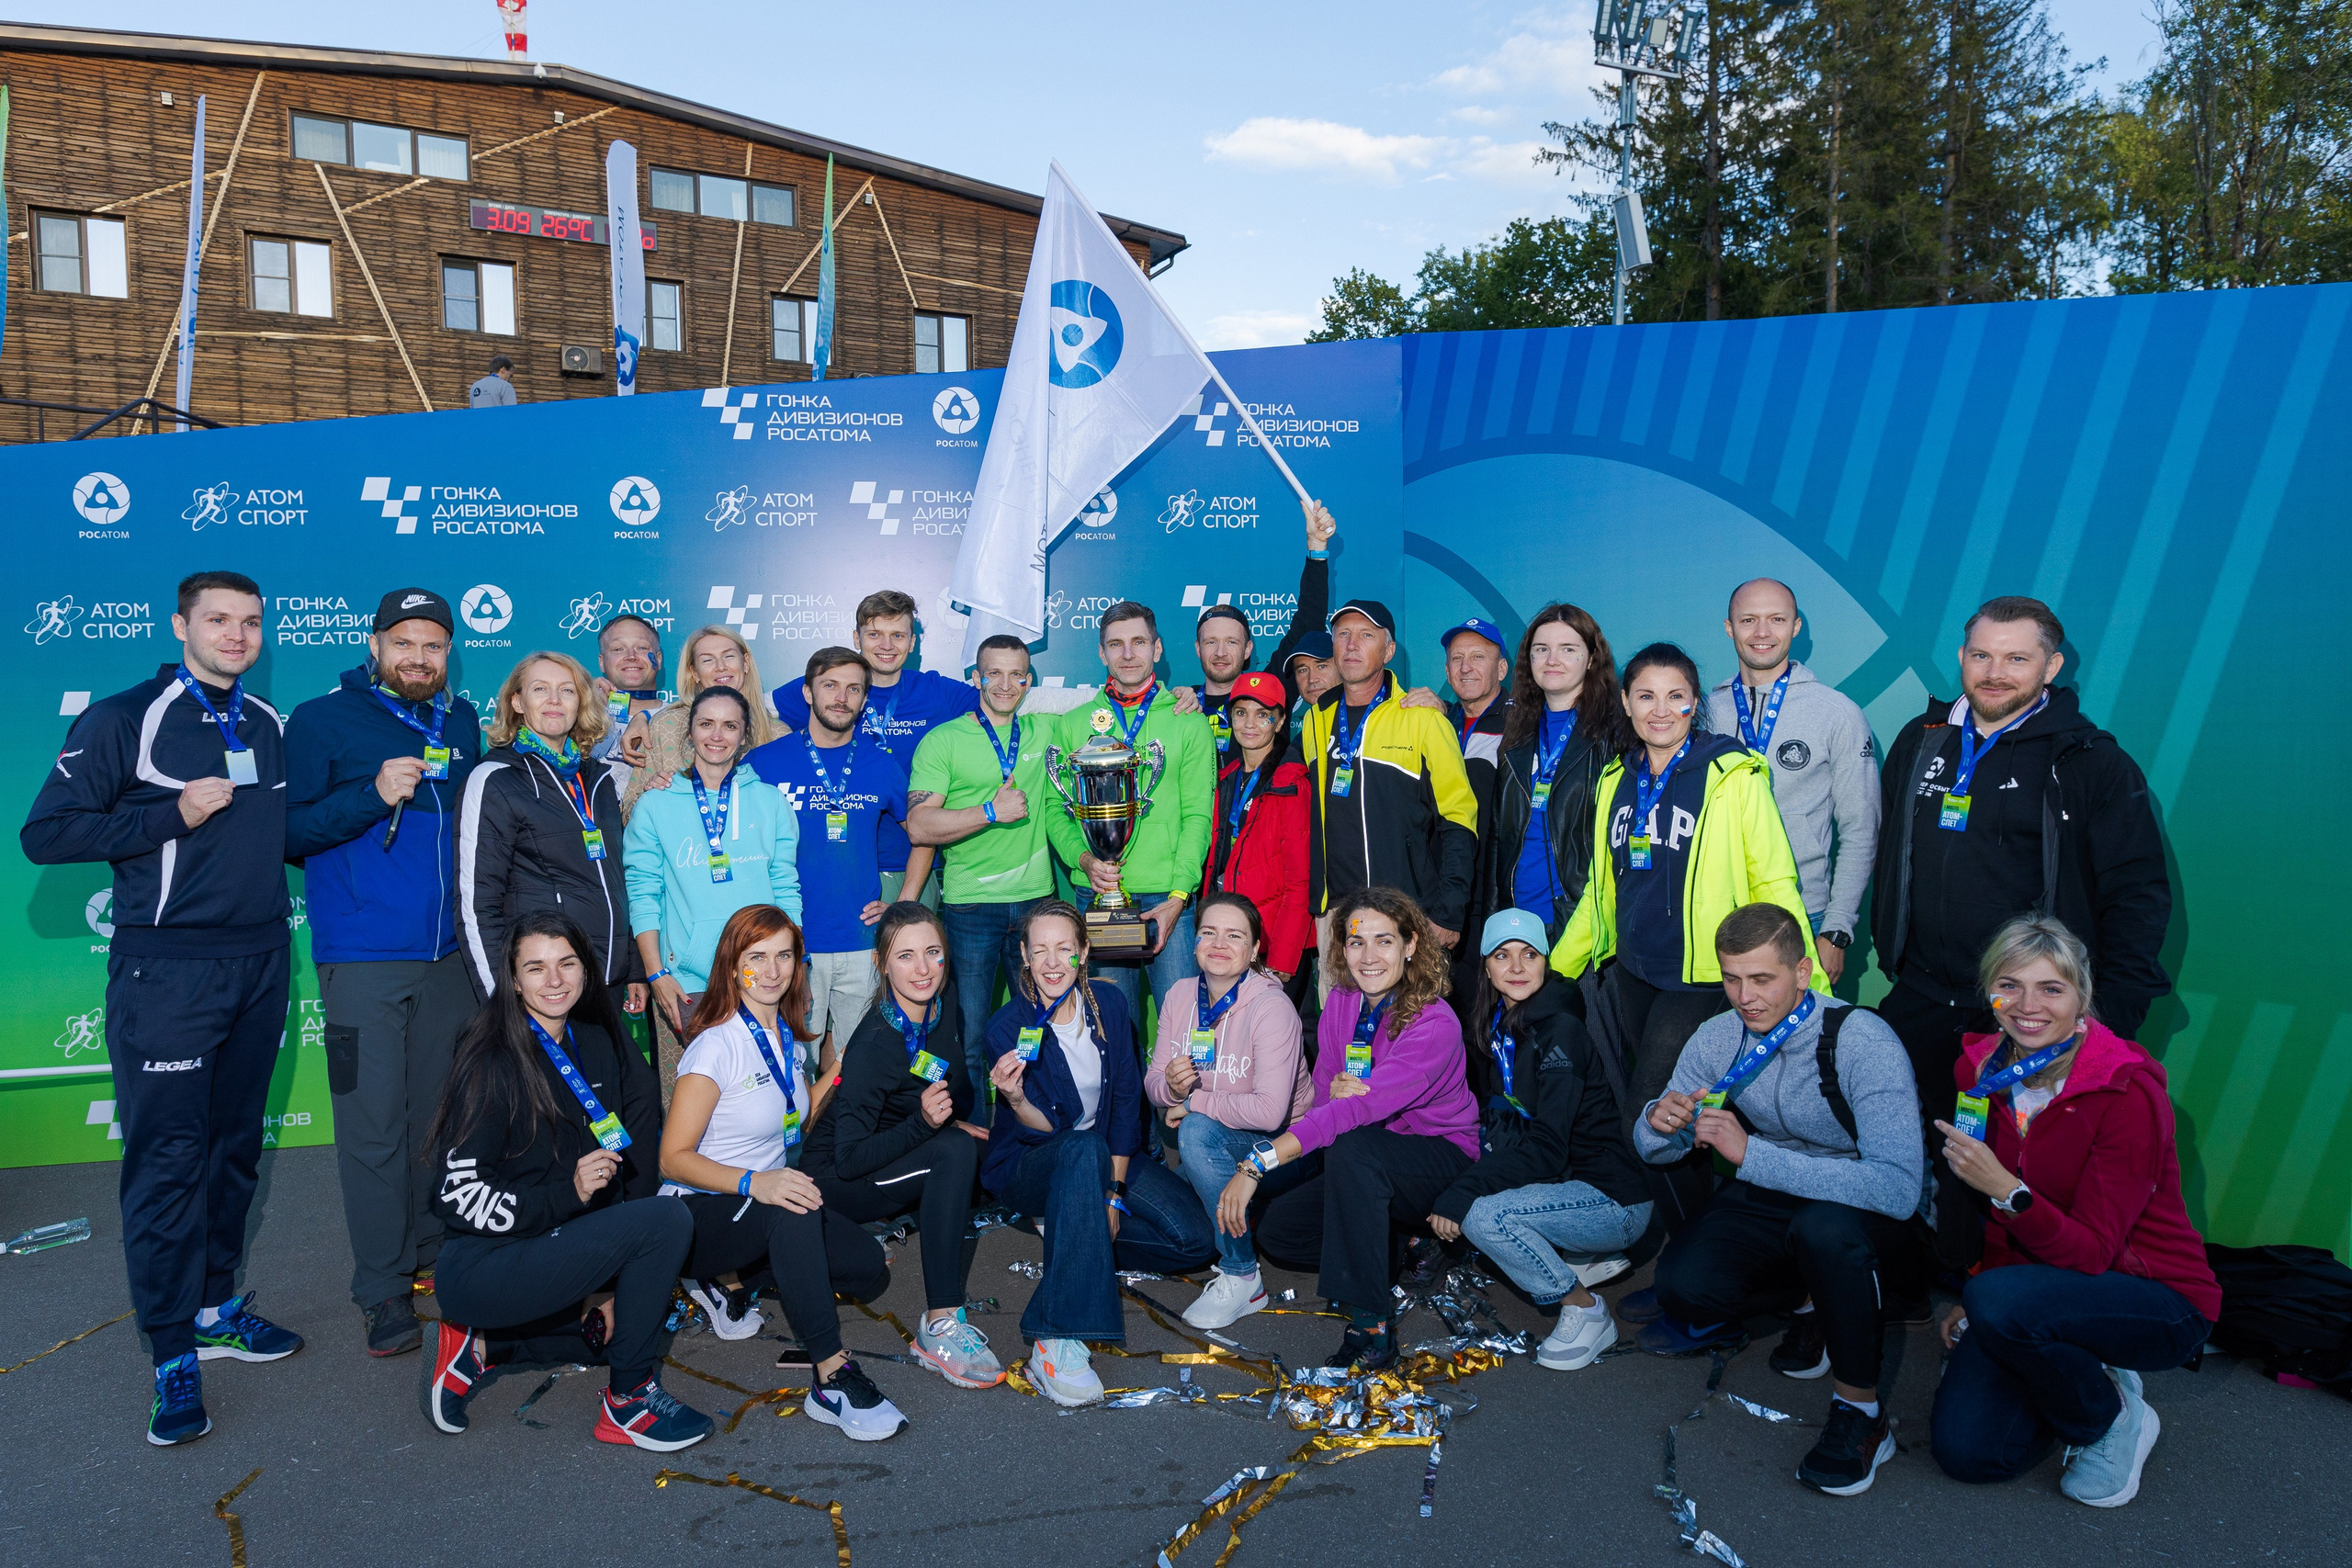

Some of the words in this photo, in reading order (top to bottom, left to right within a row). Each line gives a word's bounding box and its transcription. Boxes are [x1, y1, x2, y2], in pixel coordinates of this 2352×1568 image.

[487, 208, 531, 234] 3.09
[766, 394, 832, 409] ГОНКА
[766, 411, 903, 426] ДИВИЗИОНОВ
[767, 428, 872, 442] РОСАТОМА
[935, 439, 978, 448] РОСАТОМ
[245, 490, 304, 505] АТОМ
[431, 487, 502, 501] ГОНКА
[762, 492, 814, 508] АТОМ
[911, 491, 974, 503] ГОНКА
[432, 503, 578, 519] ДИВИЗИОНОВ
[1209, 497, 1256, 511] АТОМ
[238, 510, 309, 525] СПОРТ
[754, 512, 819, 526] СПОРТ
[1202, 514, 1260, 529] СПОРТ
[79, 531, 130, 539] РОСАТОМ
[433, 522, 545, 535] РОСАТОМА
[614, 531, 660, 539] РОСАТОМ
[913, 523, 967, 536] РОСА
[276, 597, 349, 611] ГОНКА
[405, 594, 427, 604] NIKE
[771, 594, 836, 607] ГОНКА
[1238, 593, 1298, 605] ГОНКА
[90, 603, 150, 618] АТОМ
[617, 599, 671, 614] АТОМ
[277, 614, 377, 630] ДИВИЗИ
[772, 611, 856, 626] ДИВИЗИ
[82, 623, 155, 638] СПОРТ
[773, 627, 854, 640] РОСАТО
[277, 631, 370, 645] РОСАТО
[465, 639, 512, 648] РОСАТОМ
[202, 712, 247, 723] LEGA
[1941, 811, 1963, 820] АТОМ-
[142, 1057, 202, 1072] LEGEA
[925, 1060, 939, 1080] АТОМ-
[1347, 1062, 1367, 1070] АТОМ-
[1540, 1058, 1574, 1071] adidas
[1956, 1113, 1982, 1127] АТОМ-
[602, 1131, 623, 1146] АТОМ-
[440, 1146, 517, 1232] JEANS
